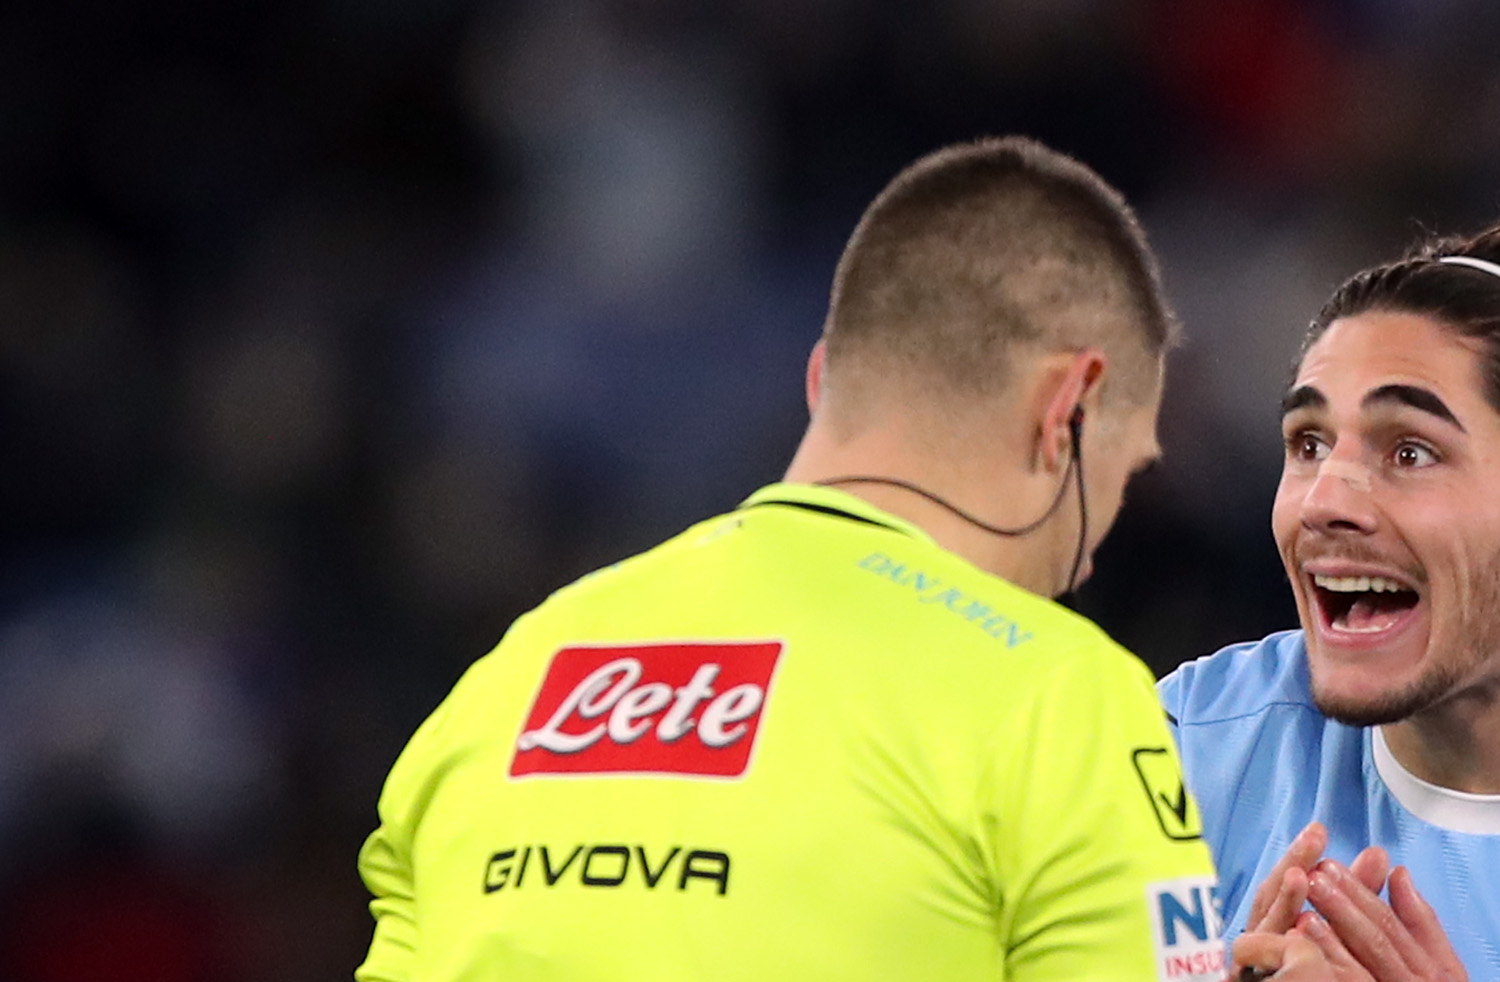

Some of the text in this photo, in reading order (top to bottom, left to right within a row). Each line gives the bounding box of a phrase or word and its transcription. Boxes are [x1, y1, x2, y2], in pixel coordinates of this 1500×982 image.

[857, 552, 1035, 649] DAN JOHN
[517, 656, 764, 754] Lete
[483, 844, 731, 895] GIVOVA
